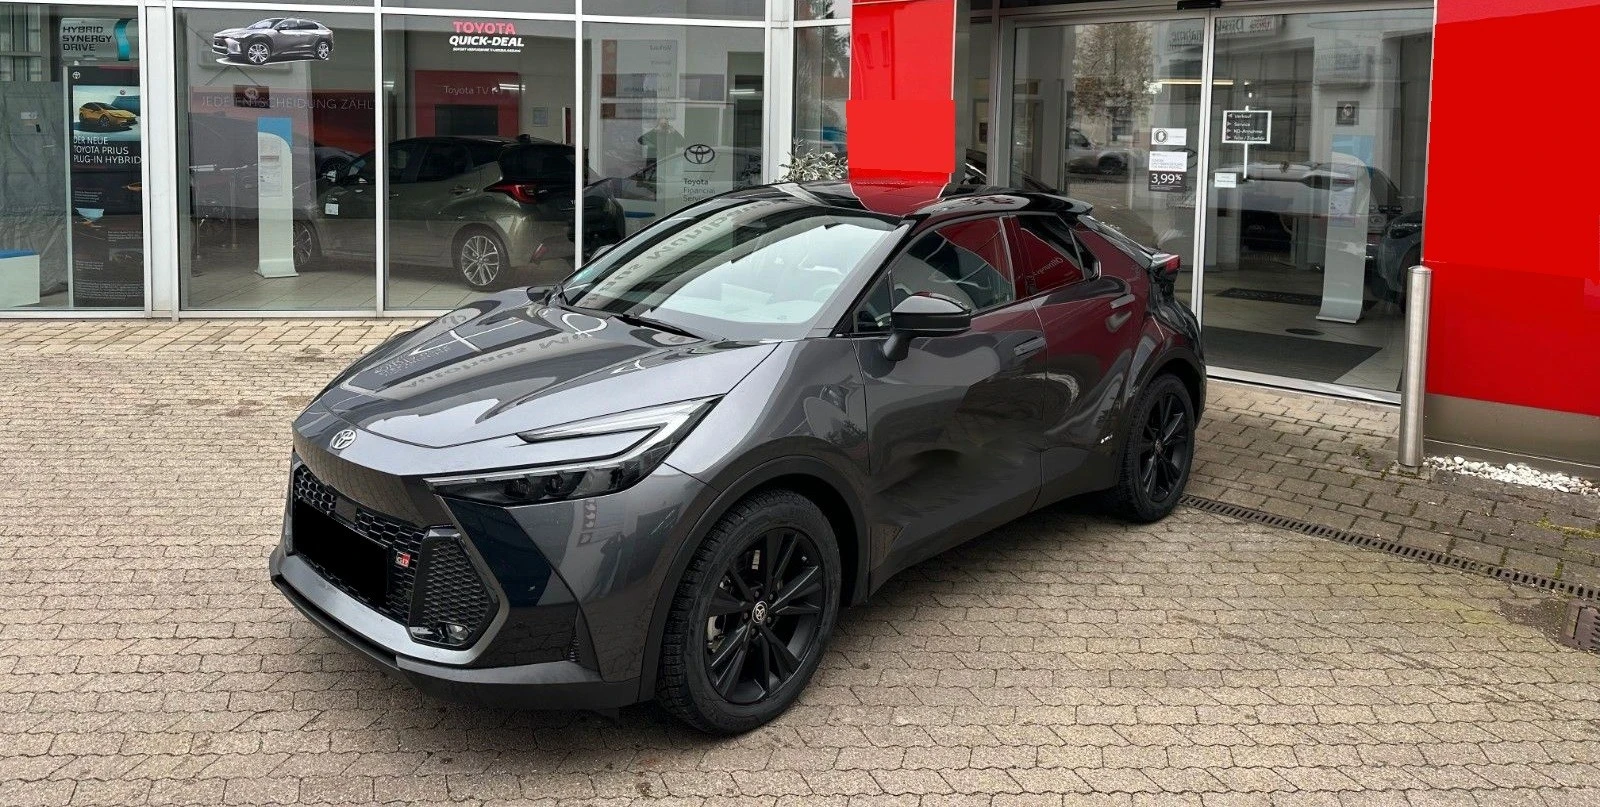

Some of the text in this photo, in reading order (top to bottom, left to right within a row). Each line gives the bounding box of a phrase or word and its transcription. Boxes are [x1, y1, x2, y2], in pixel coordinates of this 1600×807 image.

[453, 21, 516, 35] TOYOTA
[63, 34, 112, 43] SYNERGY
[449, 35, 524, 47] QUICK-DEAL
[63, 43, 96, 51] DRIVE
[443, 85, 474, 95] Toyota
[476, 86, 489, 95] TV
[73, 135, 109, 145] DER NEUE
[73, 145, 129, 155] TOYOTA PRIUS
[73, 155, 142, 164] PLUG-IN HYBRID
[684, 178, 709, 186] Toyota
[683, 194, 704, 202] Servi
